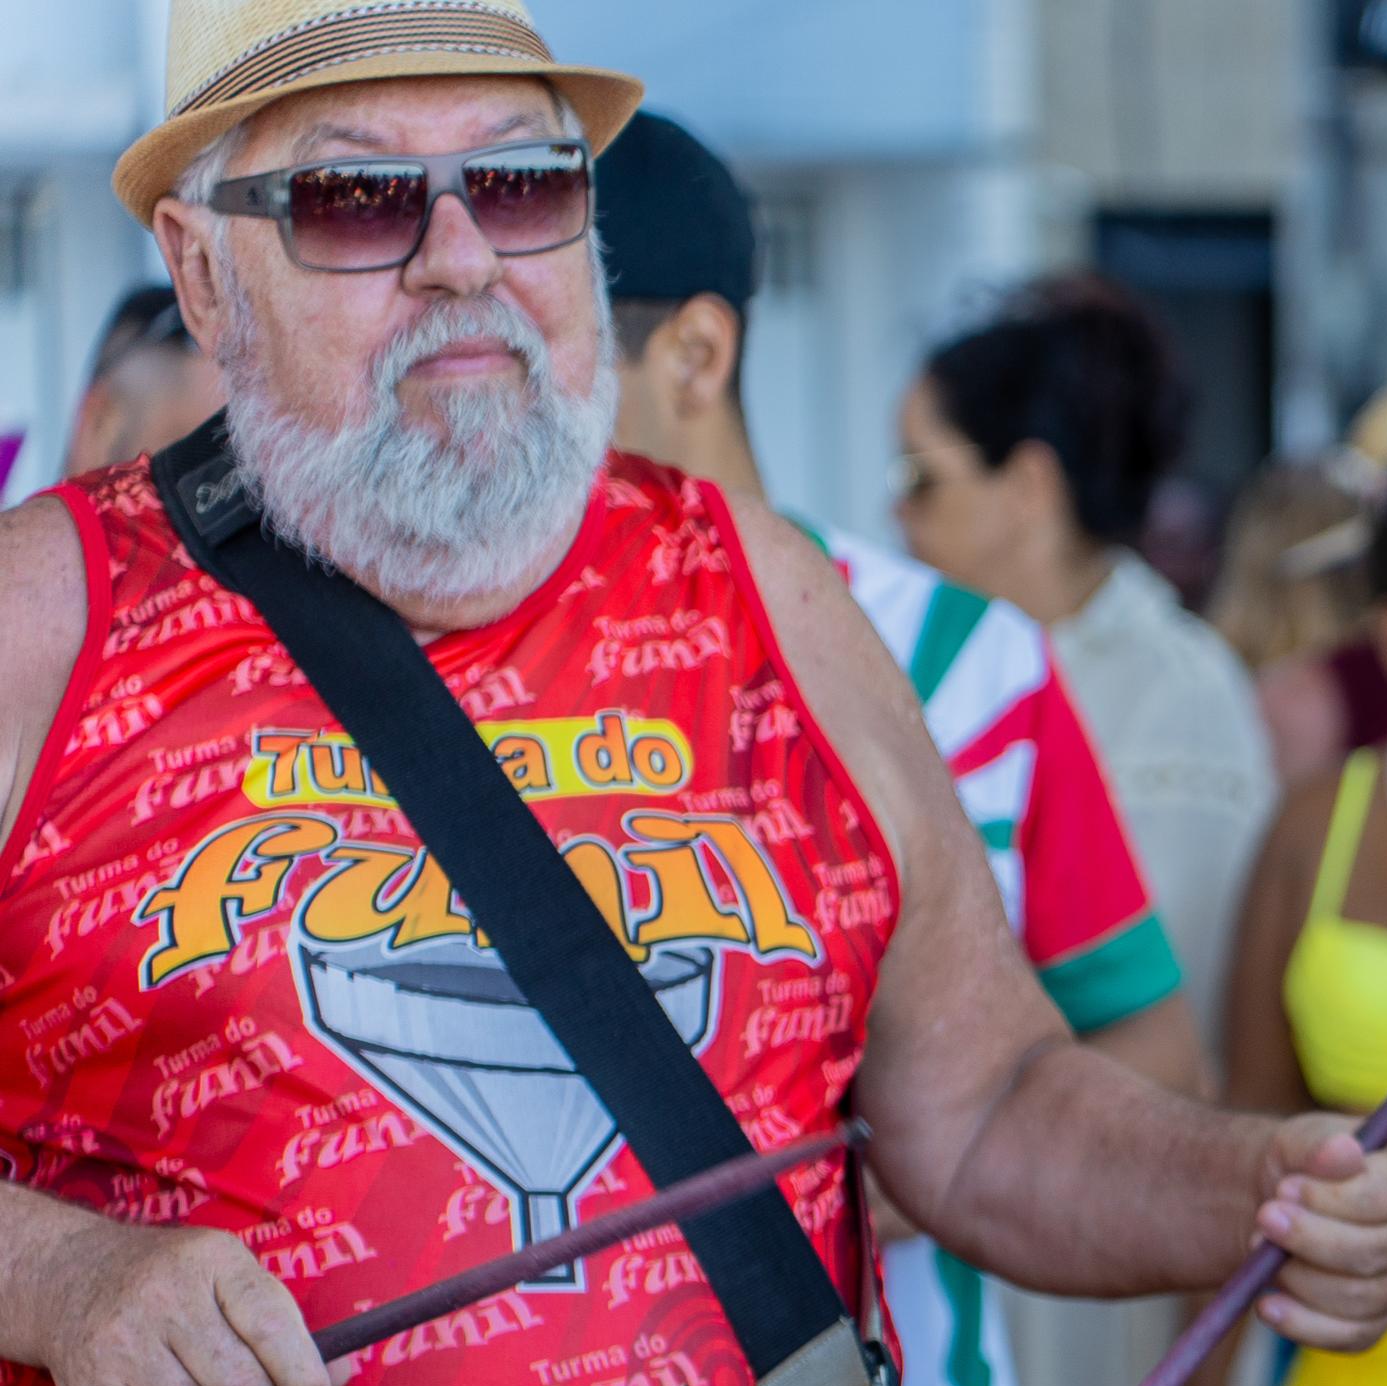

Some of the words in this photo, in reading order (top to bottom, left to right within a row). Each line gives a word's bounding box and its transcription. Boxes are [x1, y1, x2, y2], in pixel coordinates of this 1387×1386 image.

[148, 737, 237, 775] Turma
[577, 707, 687, 791] do
[52, 854, 139, 901] Turma
[146, 836, 180, 862] do
[73, 985, 98, 1011] do
[757, 976, 822, 1005] Turma
[153, 1033, 221, 1080] Turma
[225, 1015, 257, 1045] do
[294, 1088, 377, 1130] Turma
[296, 1206, 333, 1230] do
[529, 1343, 626, 1386] Turma
[633, 1332, 668, 1361] do
